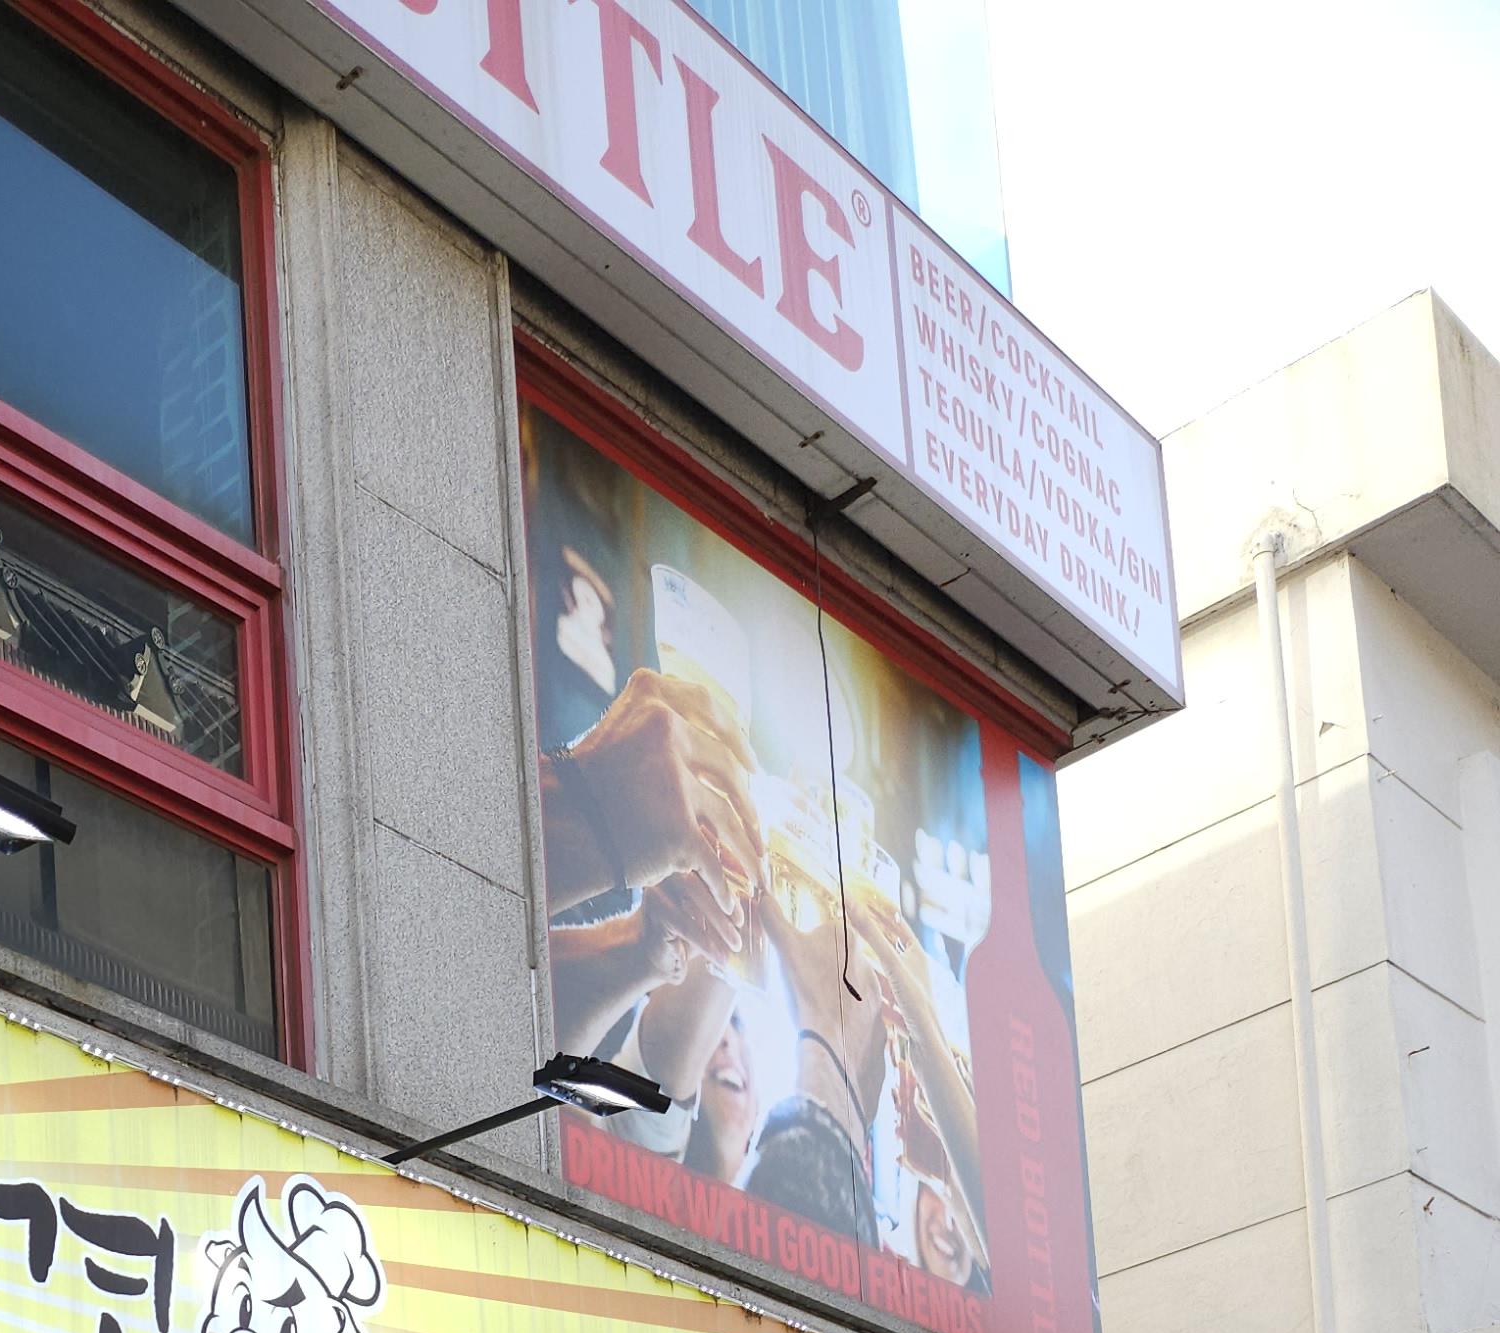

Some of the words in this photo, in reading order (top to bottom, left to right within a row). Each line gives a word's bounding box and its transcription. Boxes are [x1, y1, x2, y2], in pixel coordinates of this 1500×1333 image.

[909, 244, 1104, 450] BEER/COCKTAIL
[914, 305, 1122, 516] WHISKY/COGNAC
[919, 366, 1163, 605] TEQUILA/VODKA/GIN
[925, 429, 1049, 563] EVERYDAY
[1060, 543, 1141, 638] DRINK!
[1010, 1012, 1041, 1142] RED
[567, 1125, 684, 1219] DRINK
[686, 1179, 770, 1264] WITH
[778, 1215, 861, 1297] GOOD
